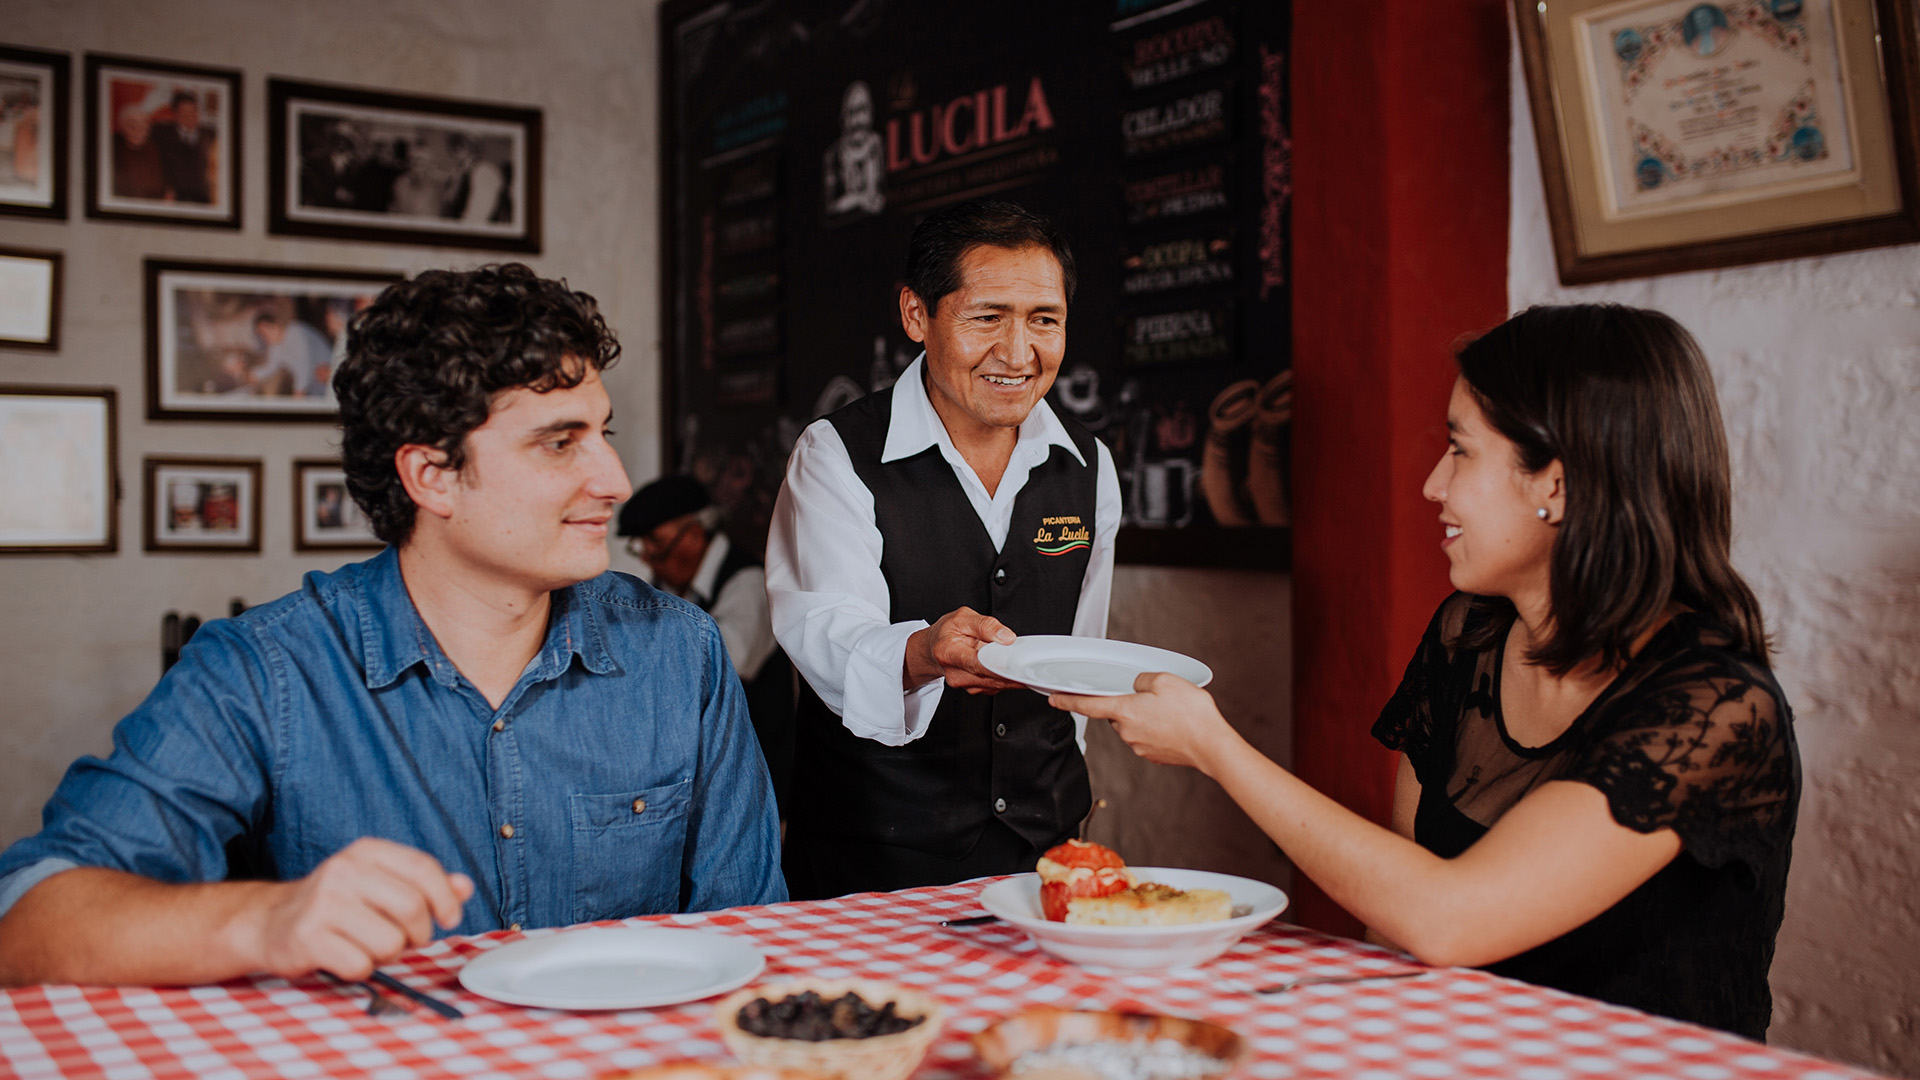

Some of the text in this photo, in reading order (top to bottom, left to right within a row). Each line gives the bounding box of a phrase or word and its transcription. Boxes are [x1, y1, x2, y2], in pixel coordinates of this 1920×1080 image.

[886, 75, 1054, 171] LUCILA
[1042, 516, 1082, 526] PICANTERIA
[1033, 527, 1054, 543] La
